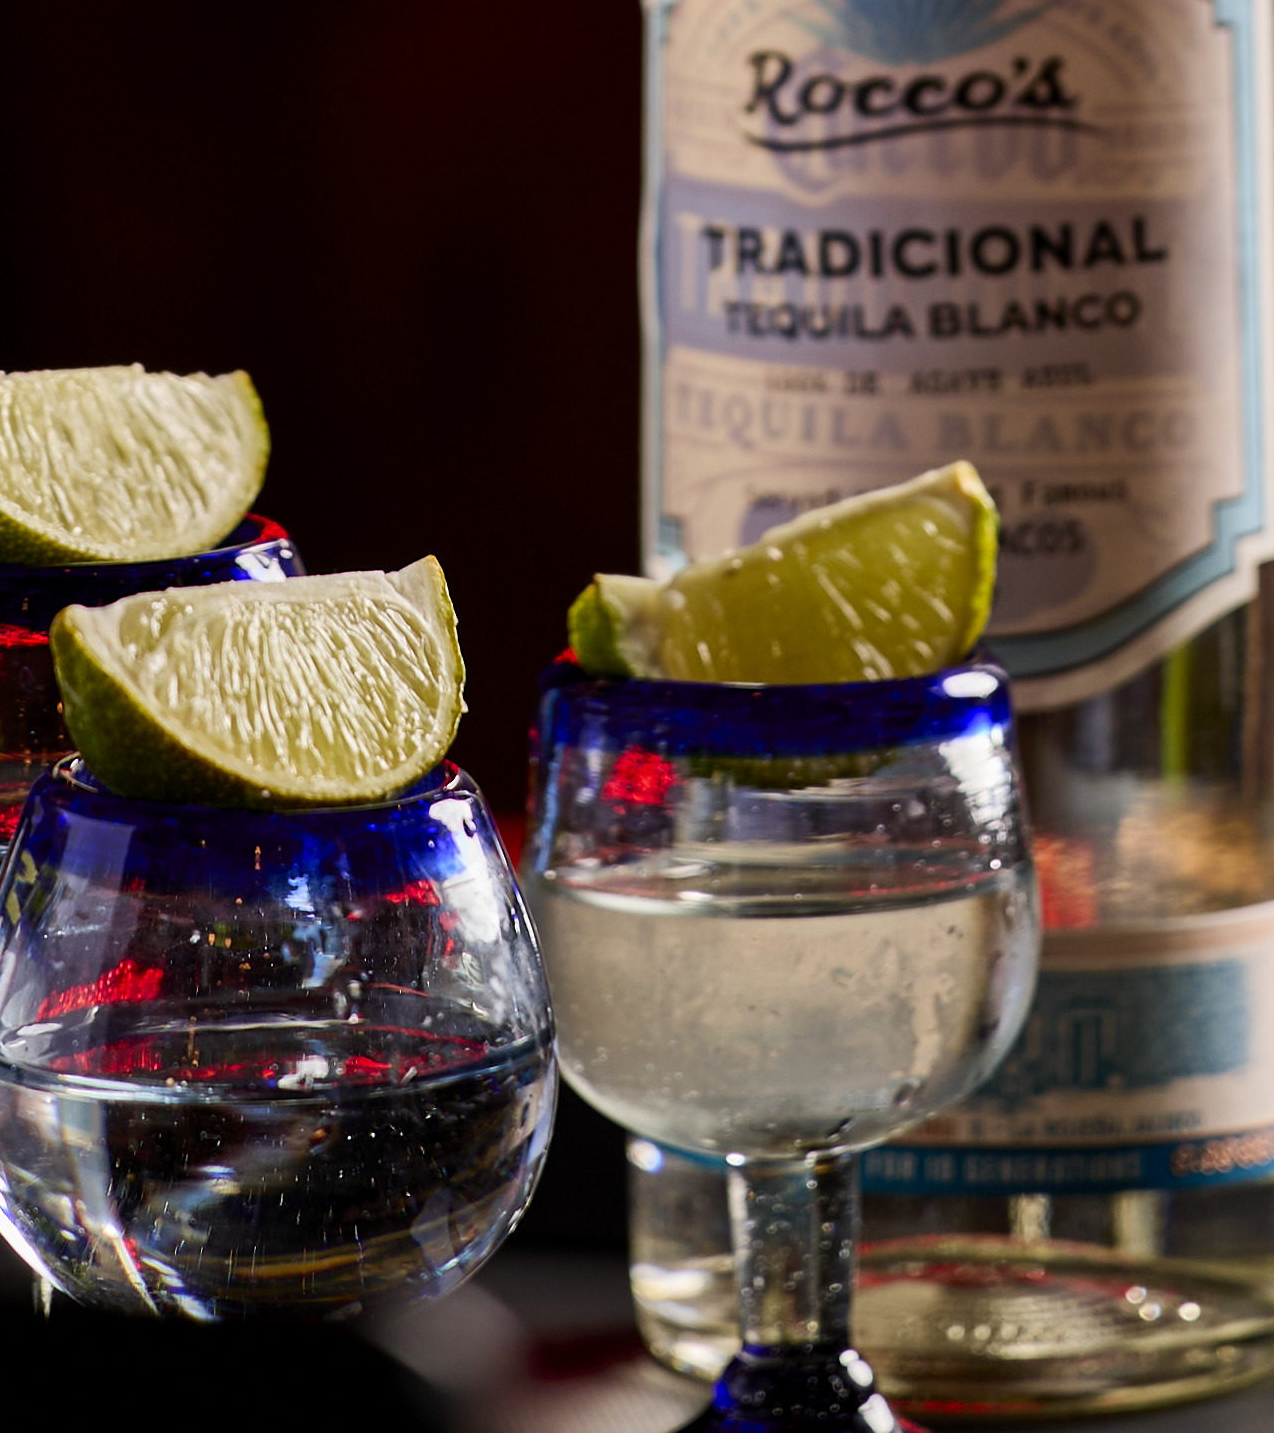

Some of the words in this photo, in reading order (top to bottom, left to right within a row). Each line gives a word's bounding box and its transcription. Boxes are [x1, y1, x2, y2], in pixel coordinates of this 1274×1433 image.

[744, 49, 1080, 127] Rocco's
[702, 215, 1169, 279] TRADICIONAL
[725, 298, 916, 343] TEQUILA
[929, 291, 1141, 339] BLANCO
[996, 516, 1087, 554] ACOS
